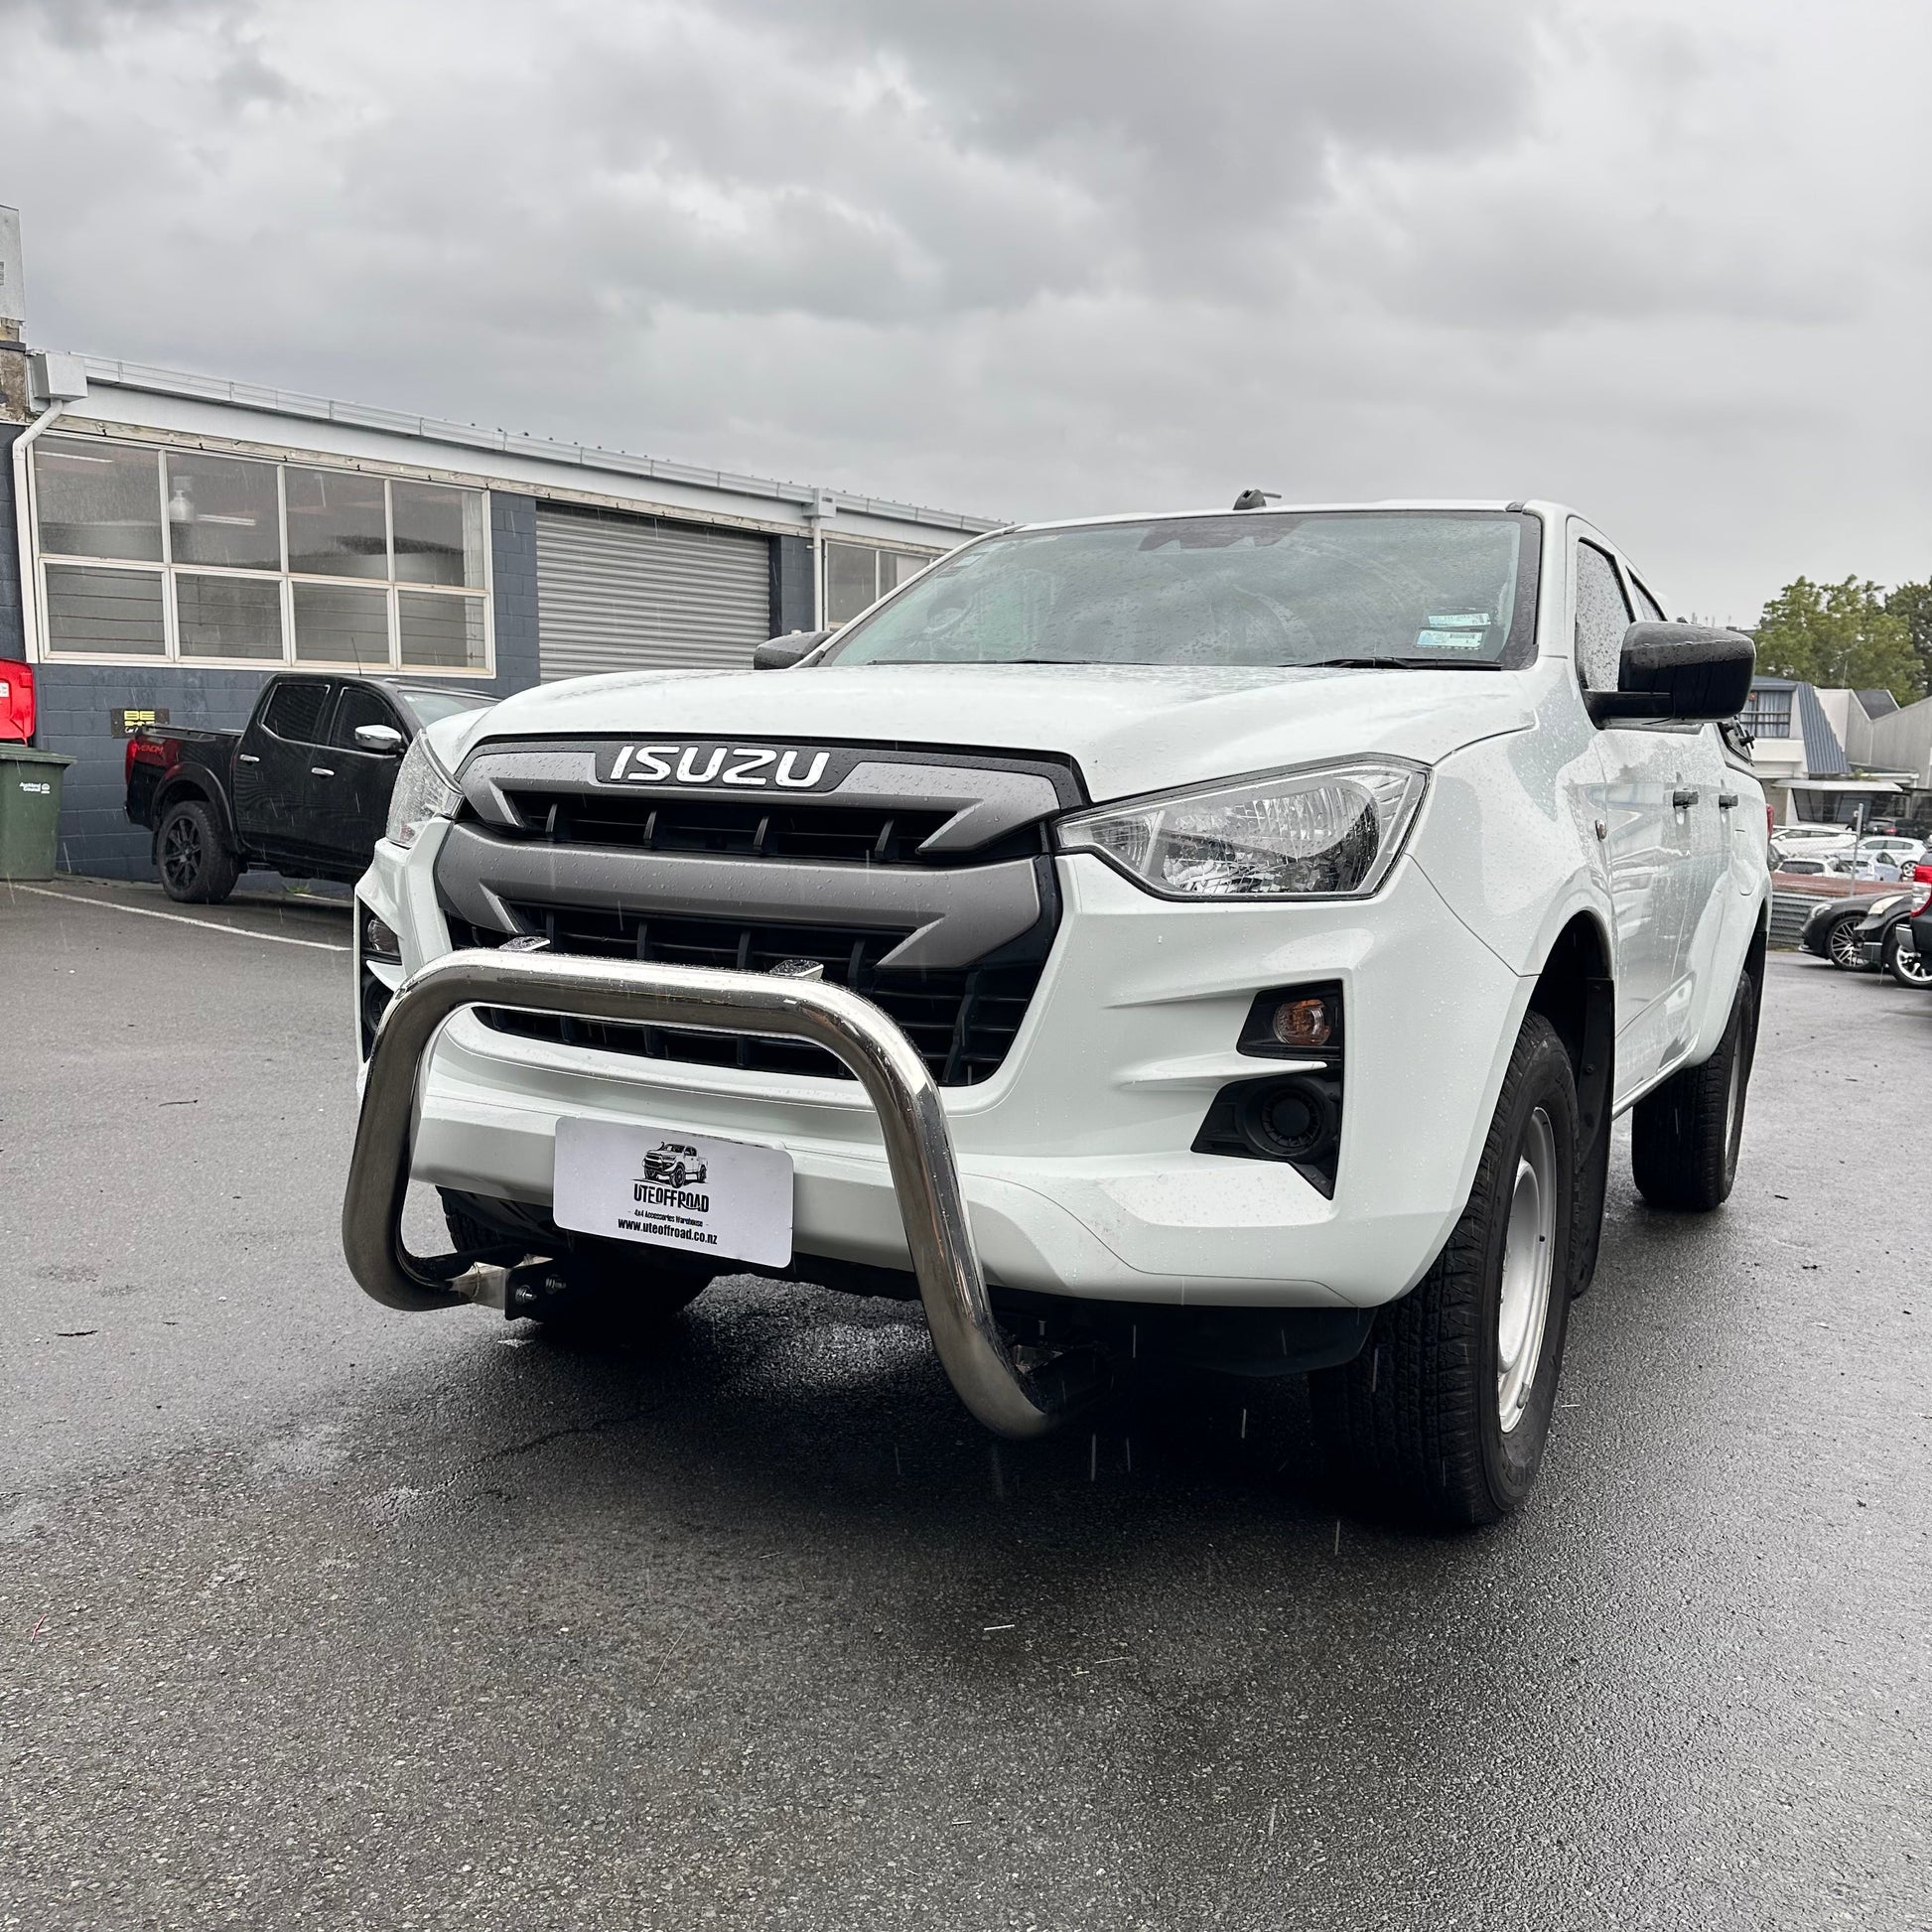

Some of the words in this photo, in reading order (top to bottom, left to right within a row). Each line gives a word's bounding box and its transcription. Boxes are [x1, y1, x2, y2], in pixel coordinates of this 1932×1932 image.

[610, 746, 830, 787] ISUZU
[633, 1183, 710, 1212] UTEOFFROAD
[618, 1218, 718, 1245] www.uteoffroad.co.nz
[644, 1210, 675, 1223] Accessories
[675, 1215, 704, 1227] Warehouse
